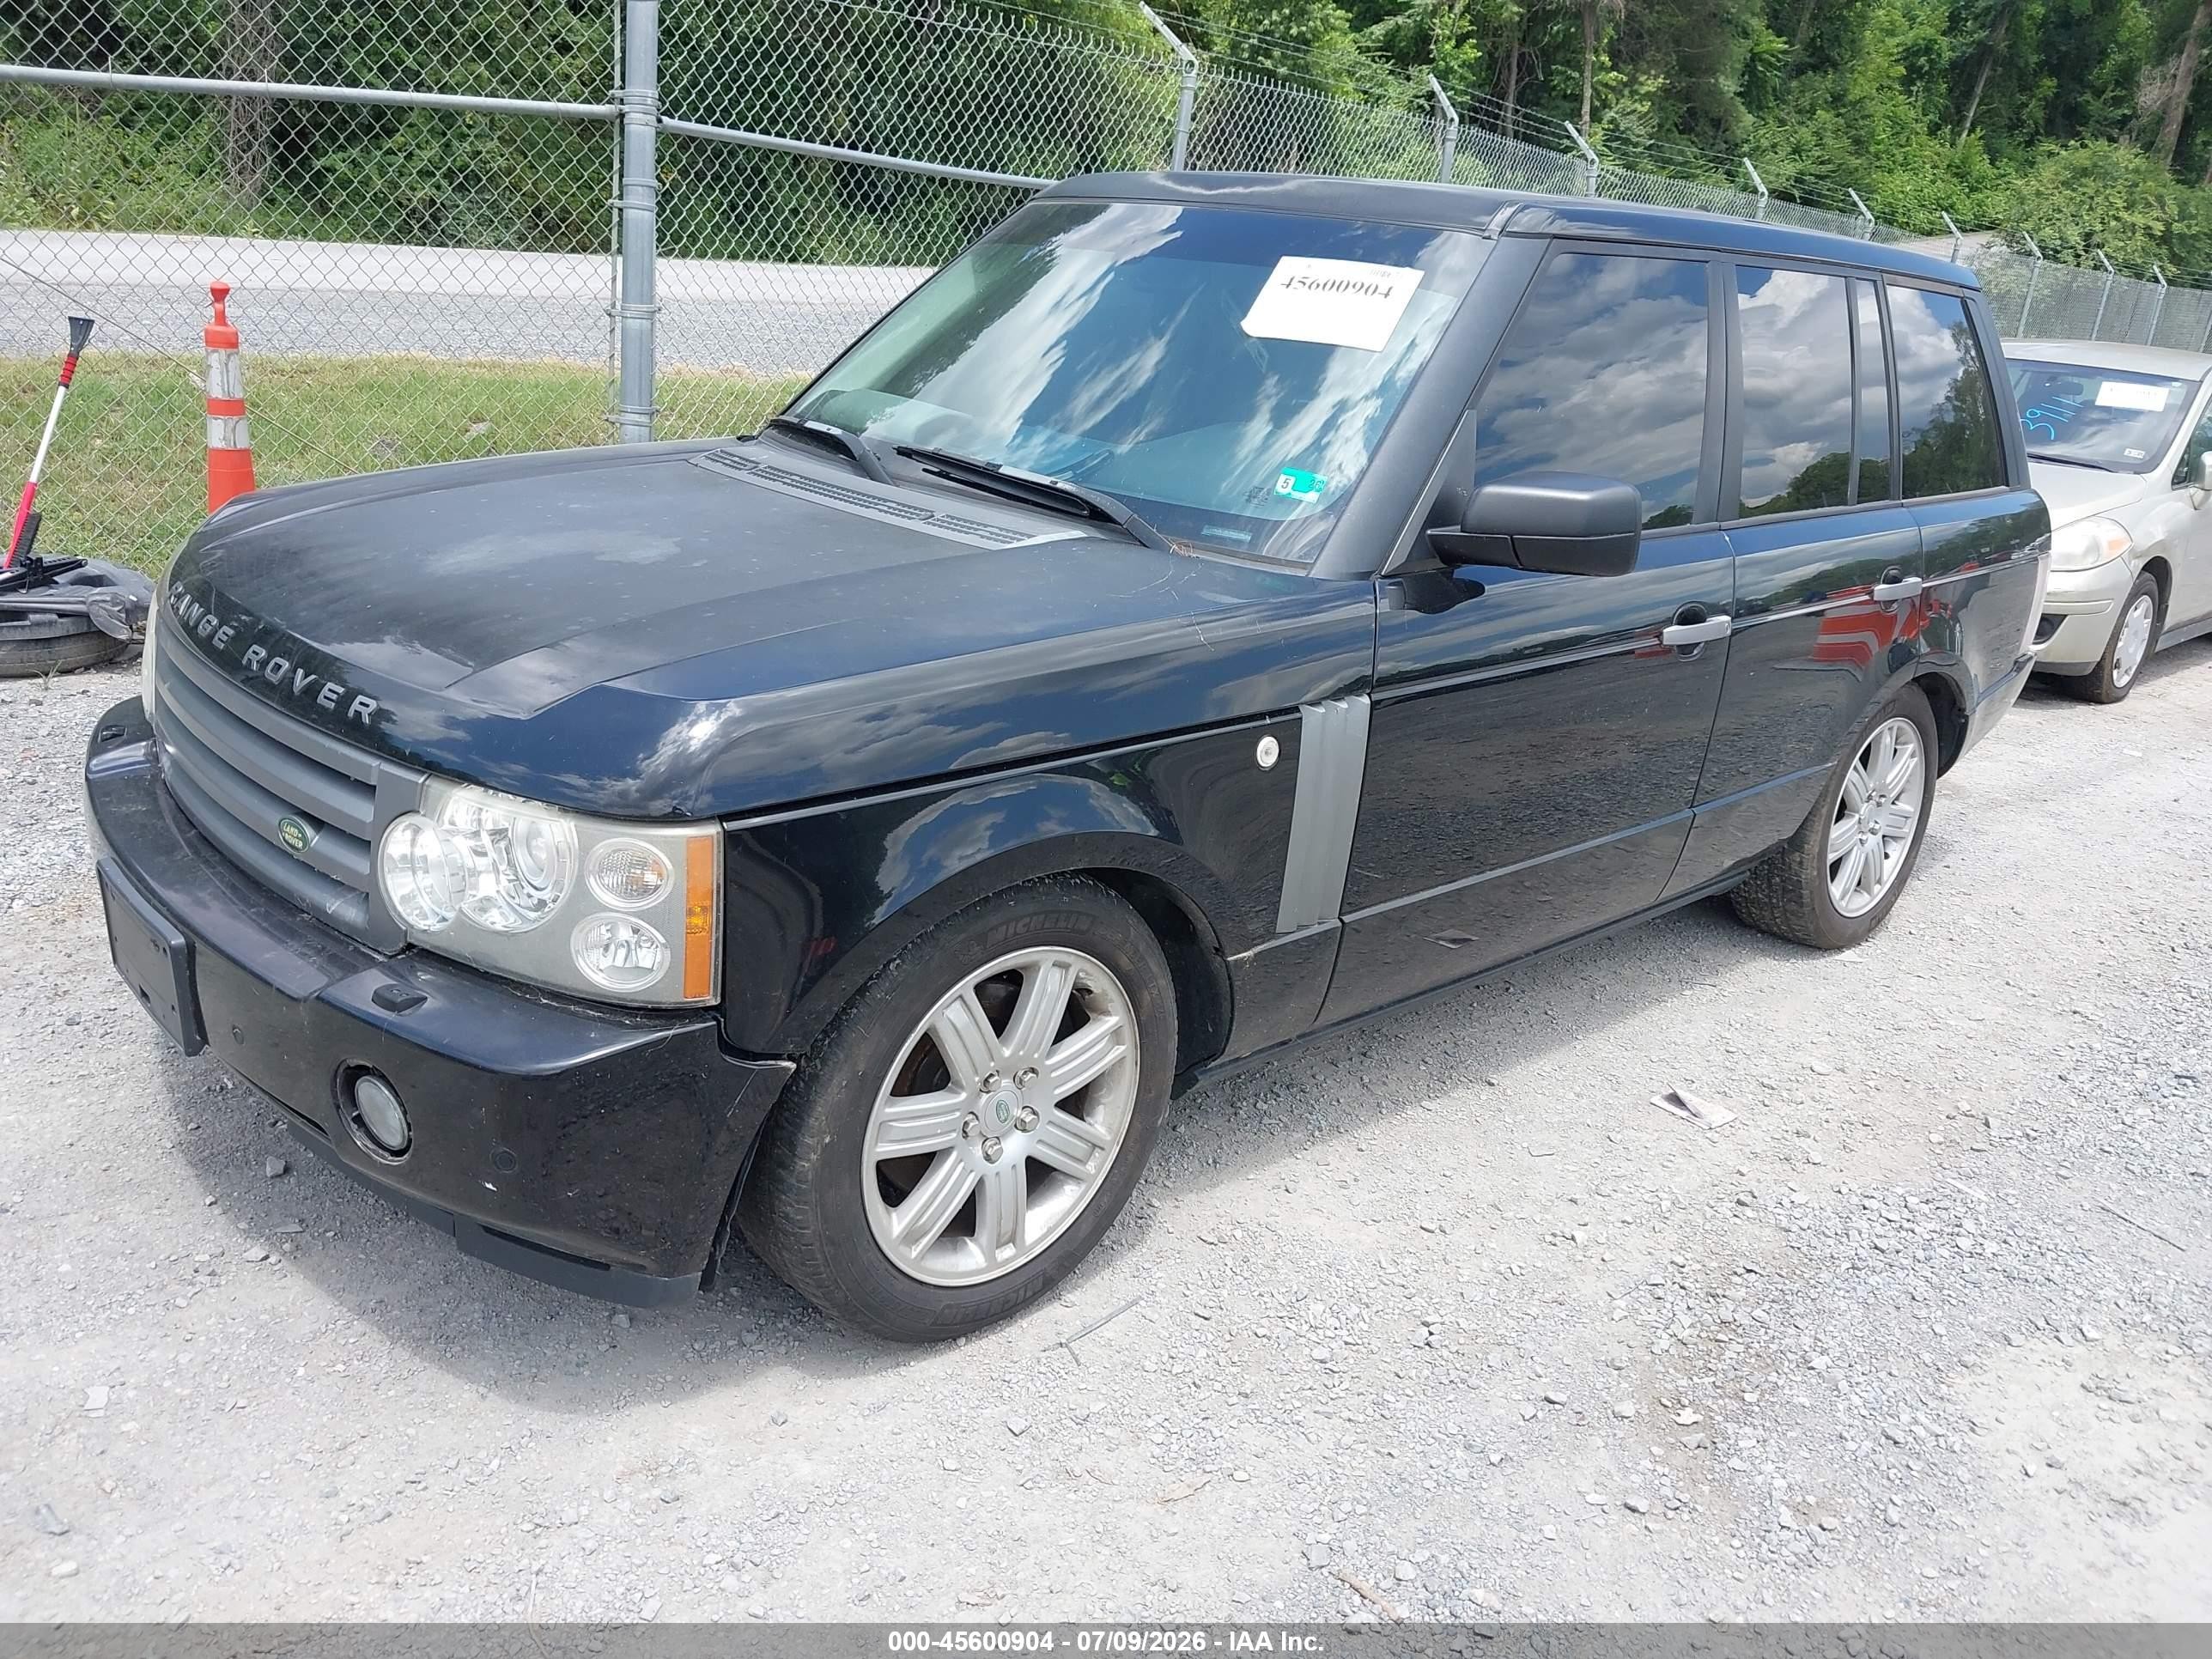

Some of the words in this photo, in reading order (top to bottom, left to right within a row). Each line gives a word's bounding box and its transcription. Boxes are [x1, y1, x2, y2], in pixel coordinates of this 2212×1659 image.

[1280, 276, 1394, 298] 45600904
[1281, 478, 1291, 489] 5
[171, 580, 235, 650] RANGE
[241, 645, 379, 725] ROVER
[283, 822, 299, 837] LAND
[284, 832, 304, 849] ROVER
